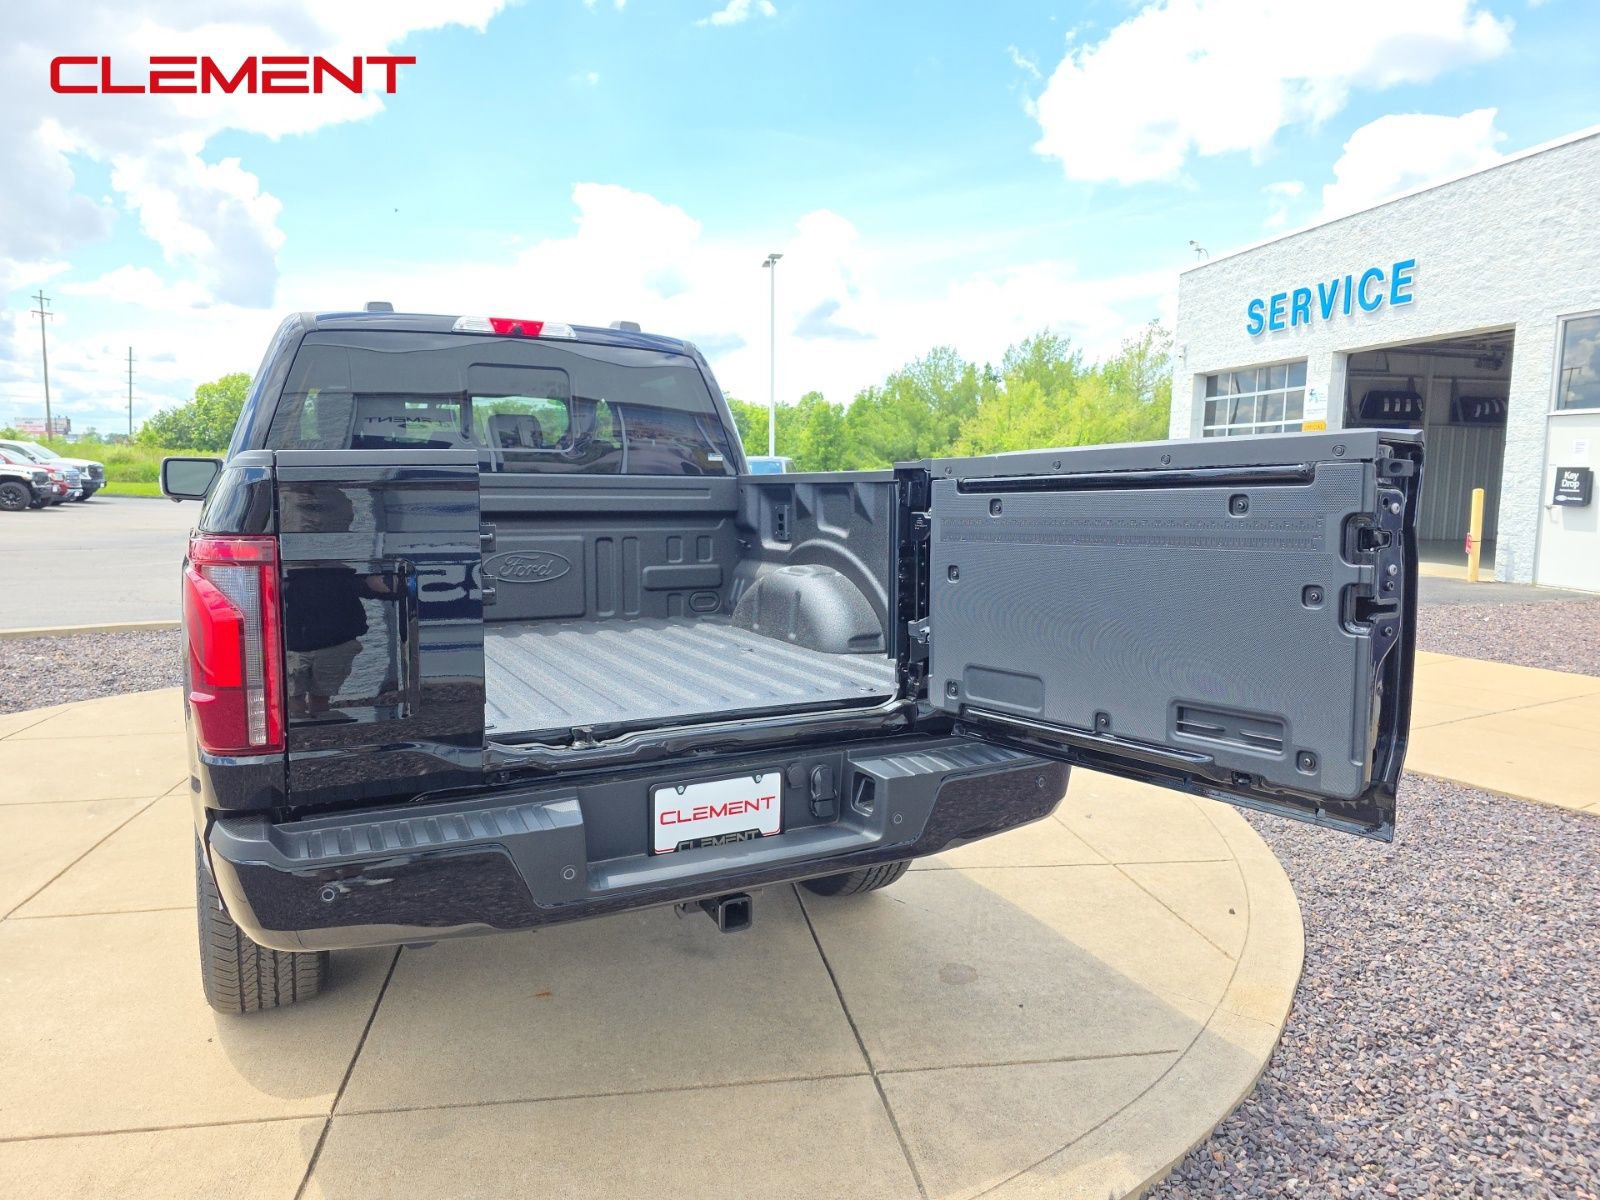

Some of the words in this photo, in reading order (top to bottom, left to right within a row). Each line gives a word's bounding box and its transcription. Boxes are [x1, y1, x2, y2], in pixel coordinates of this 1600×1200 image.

[1246, 258, 1416, 336] SERVICE
[1561, 479, 1579, 489] Drop
[1564, 471, 1579, 481] Key
[499, 554, 554, 577] Ford
[660, 796, 776, 825] CLEMENT
